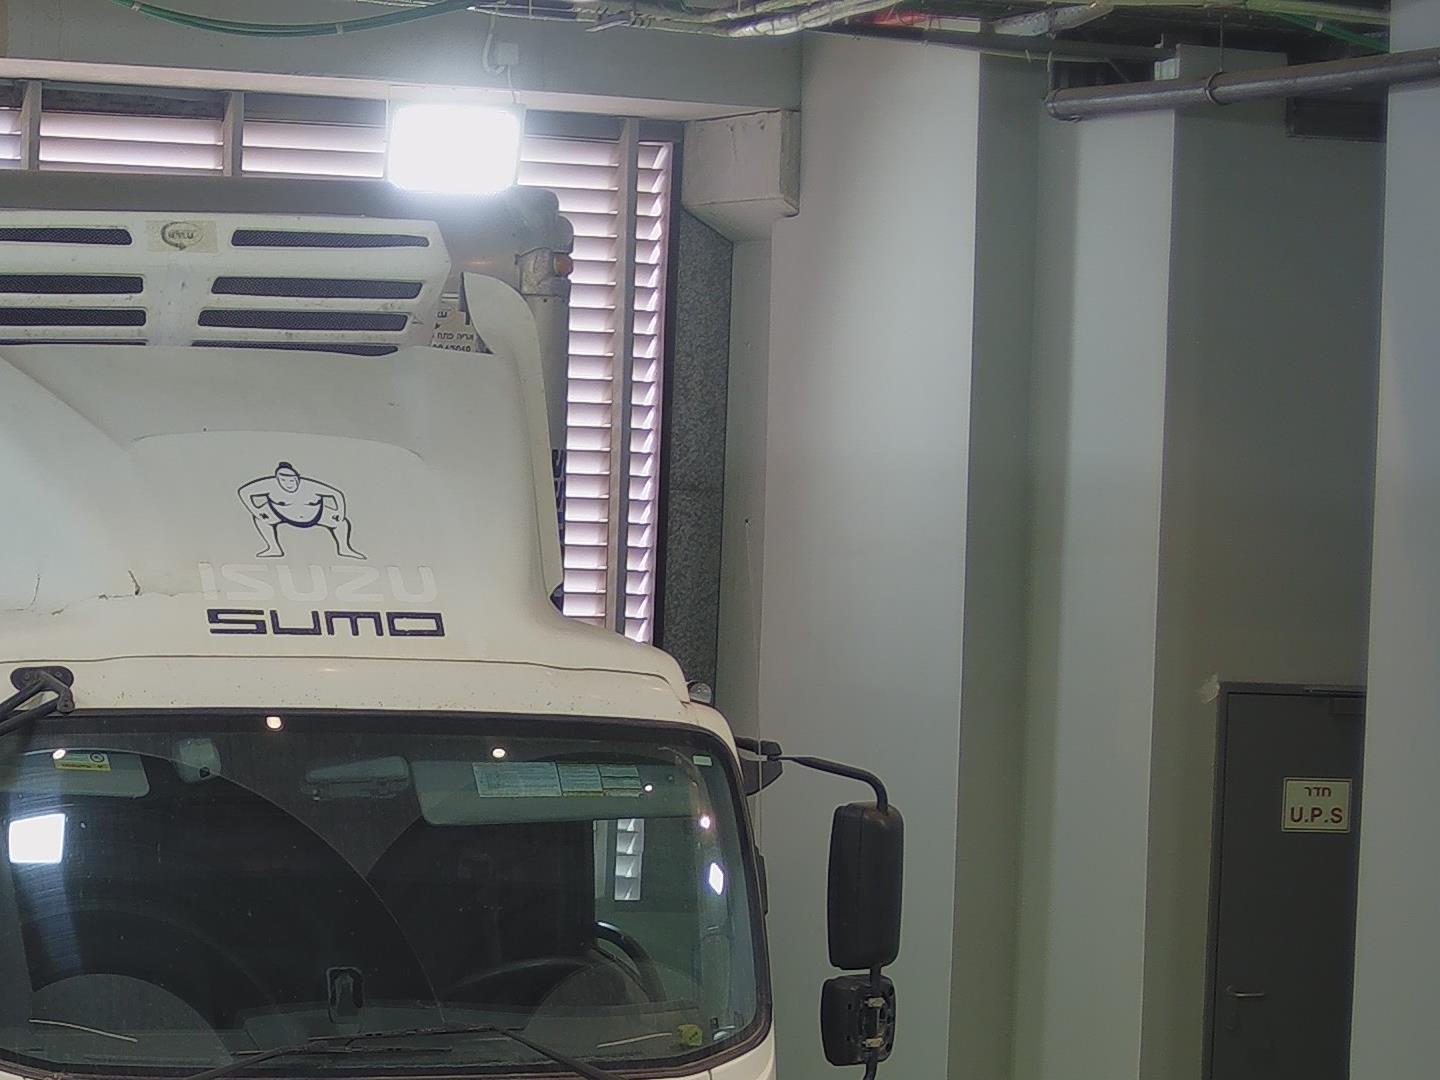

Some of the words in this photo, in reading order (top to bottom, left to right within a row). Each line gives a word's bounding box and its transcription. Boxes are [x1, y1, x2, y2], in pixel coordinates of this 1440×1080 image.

[198, 561, 439, 603] ISUZU
[206, 608, 446, 637] SUMO
[1304, 786, 1332, 797] חדר
[1290, 806, 1343, 824] U.P.S
